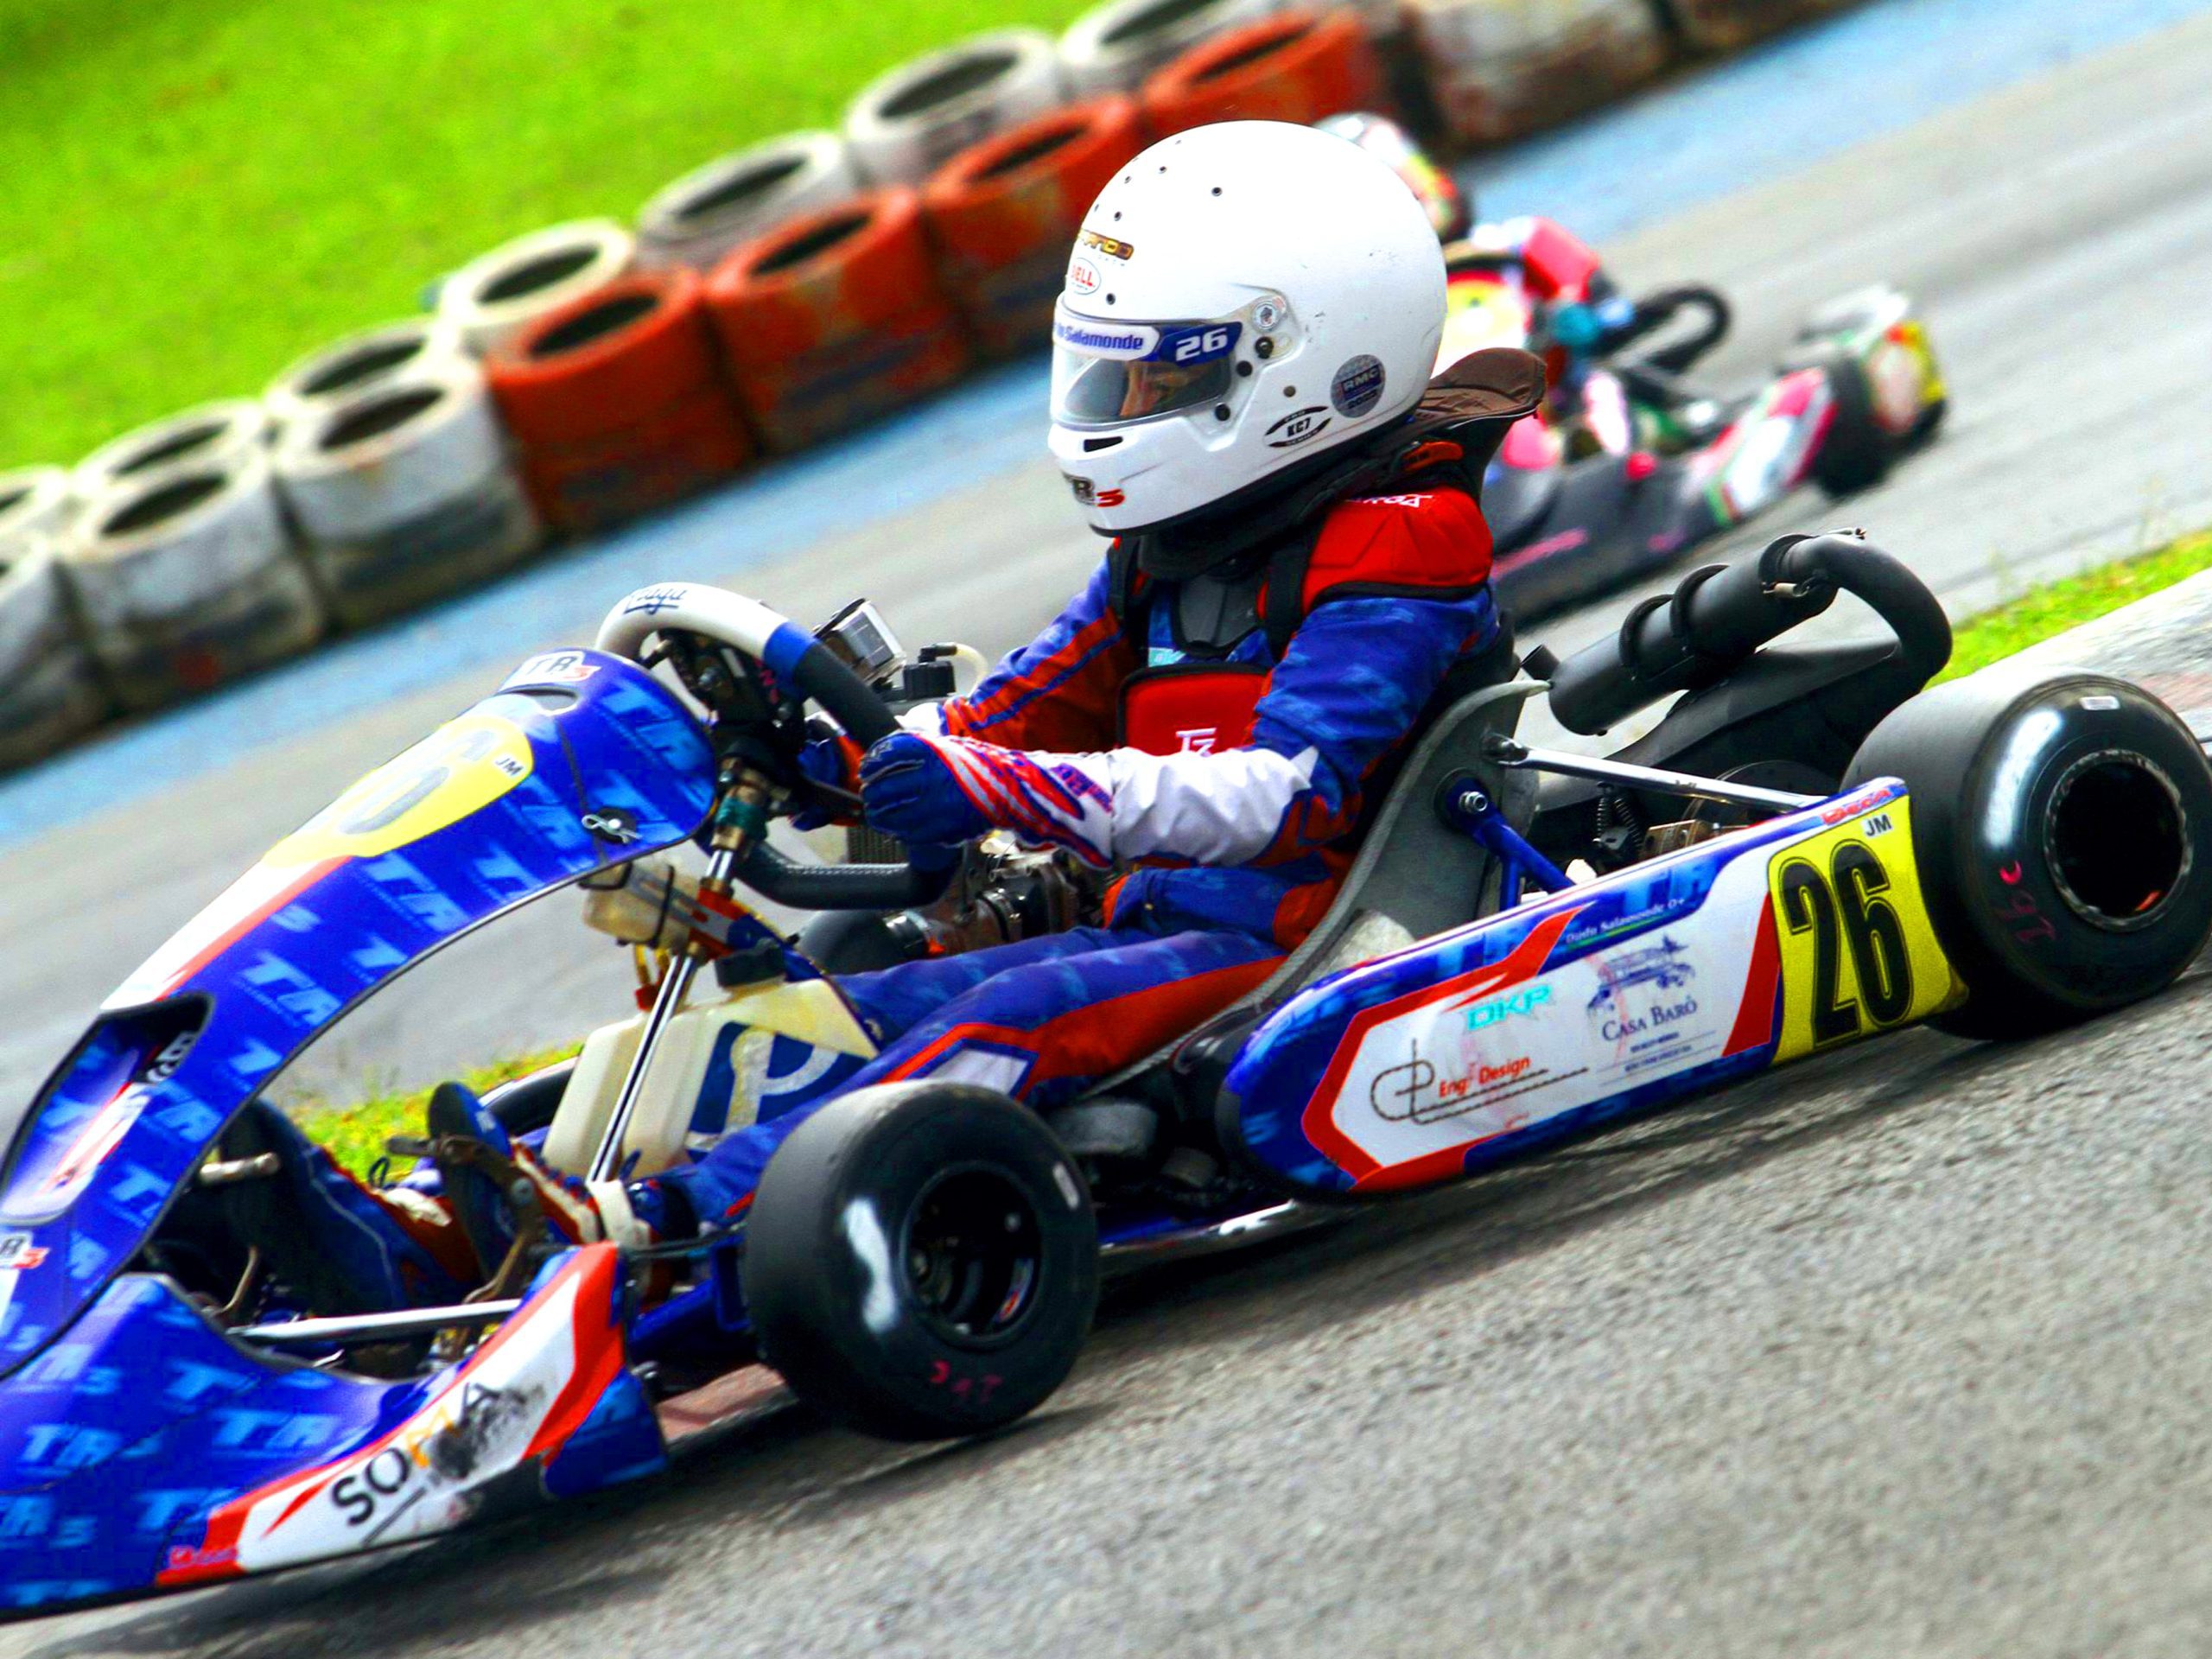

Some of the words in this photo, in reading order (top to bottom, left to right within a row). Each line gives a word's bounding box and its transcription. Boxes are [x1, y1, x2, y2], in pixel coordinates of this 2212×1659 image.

[1064, 324, 1144, 351] Salamonde
[1175, 327, 1228, 362] 26
[495, 755, 524, 777] JM
[1866, 813, 1892, 837] JM
[1777, 838, 1912, 1044] 26
[1478, 1056, 1531, 1085] Design
